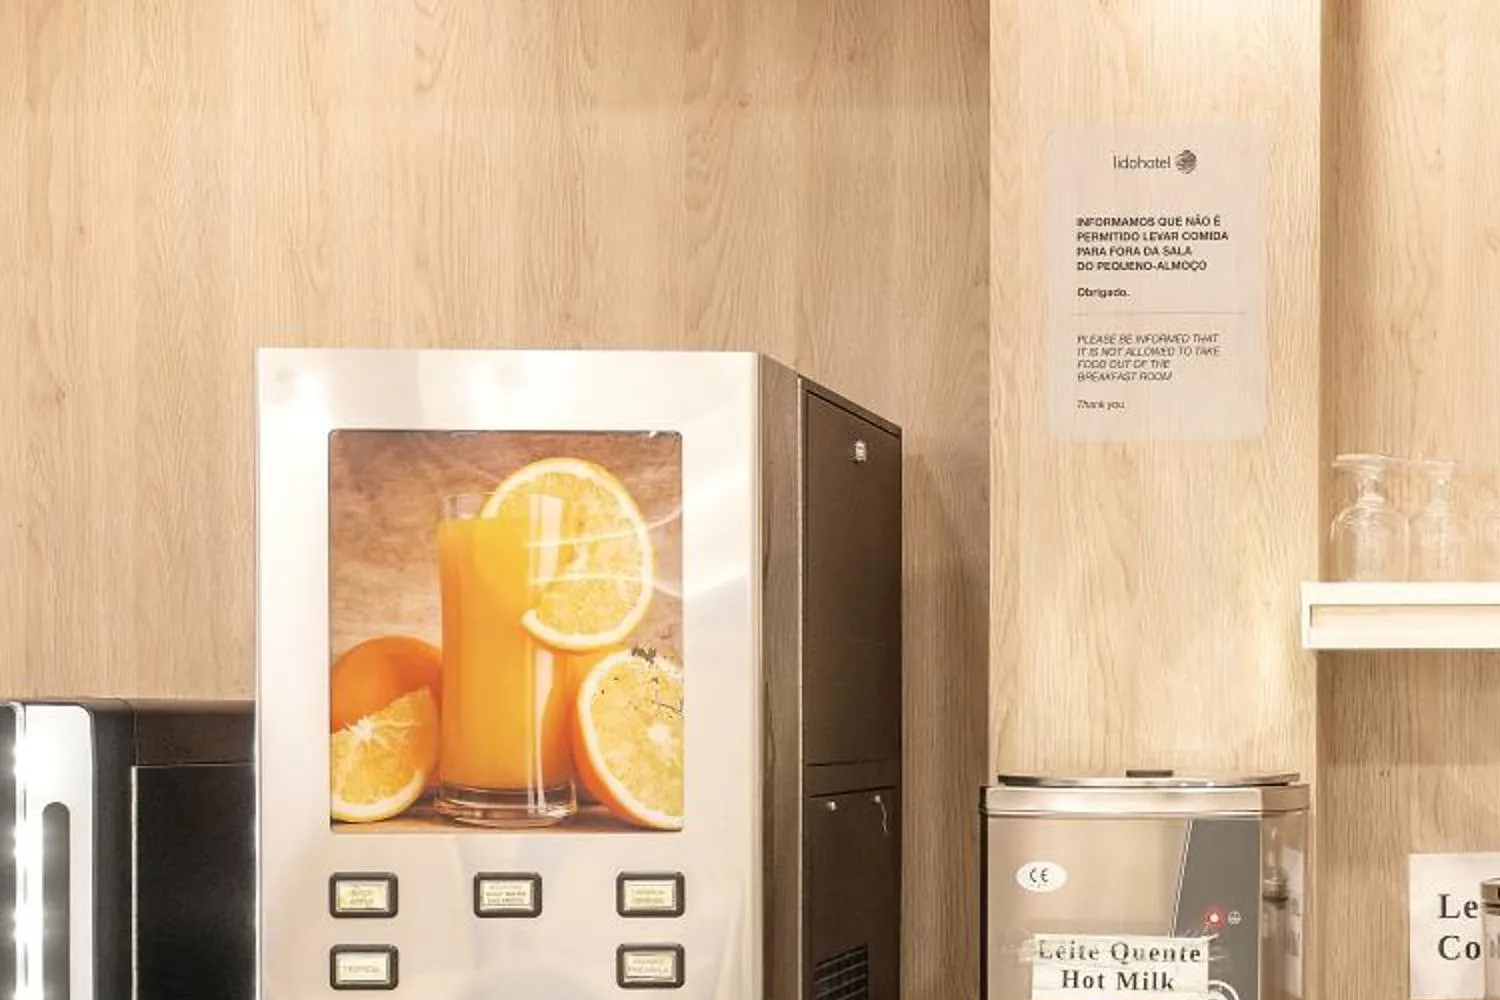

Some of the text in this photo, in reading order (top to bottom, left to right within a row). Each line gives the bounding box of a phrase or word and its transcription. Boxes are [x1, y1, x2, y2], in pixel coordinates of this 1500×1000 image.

[1076, 217, 1155, 227] INFORMAMOS
[1157, 217, 1183, 227] QUE
[1185, 214, 1211, 227] NÃO
[1076, 231, 1229, 241] PERMITIDO LEVAR COMIDA
[1076, 245, 1193, 256] PARA FORA DA SALA
[1076, 260, 1094, 271] DO
[1077, 333, 1220, 345] PLEASE BE INFORMED THAT
[1077, 345, 1221, 357] IT IS NOT ALLOWED TO TAKE
[1077, 359, 1171, 369] FOOD OUT OF THE
[1077, 371, 1138, 382] BREAKFAST
[1077, 399, 1105, 409] Thank
[1038, 940, 1202, 965] Leite Quente
[1061, 969, 1176, 991] Hot Milk
